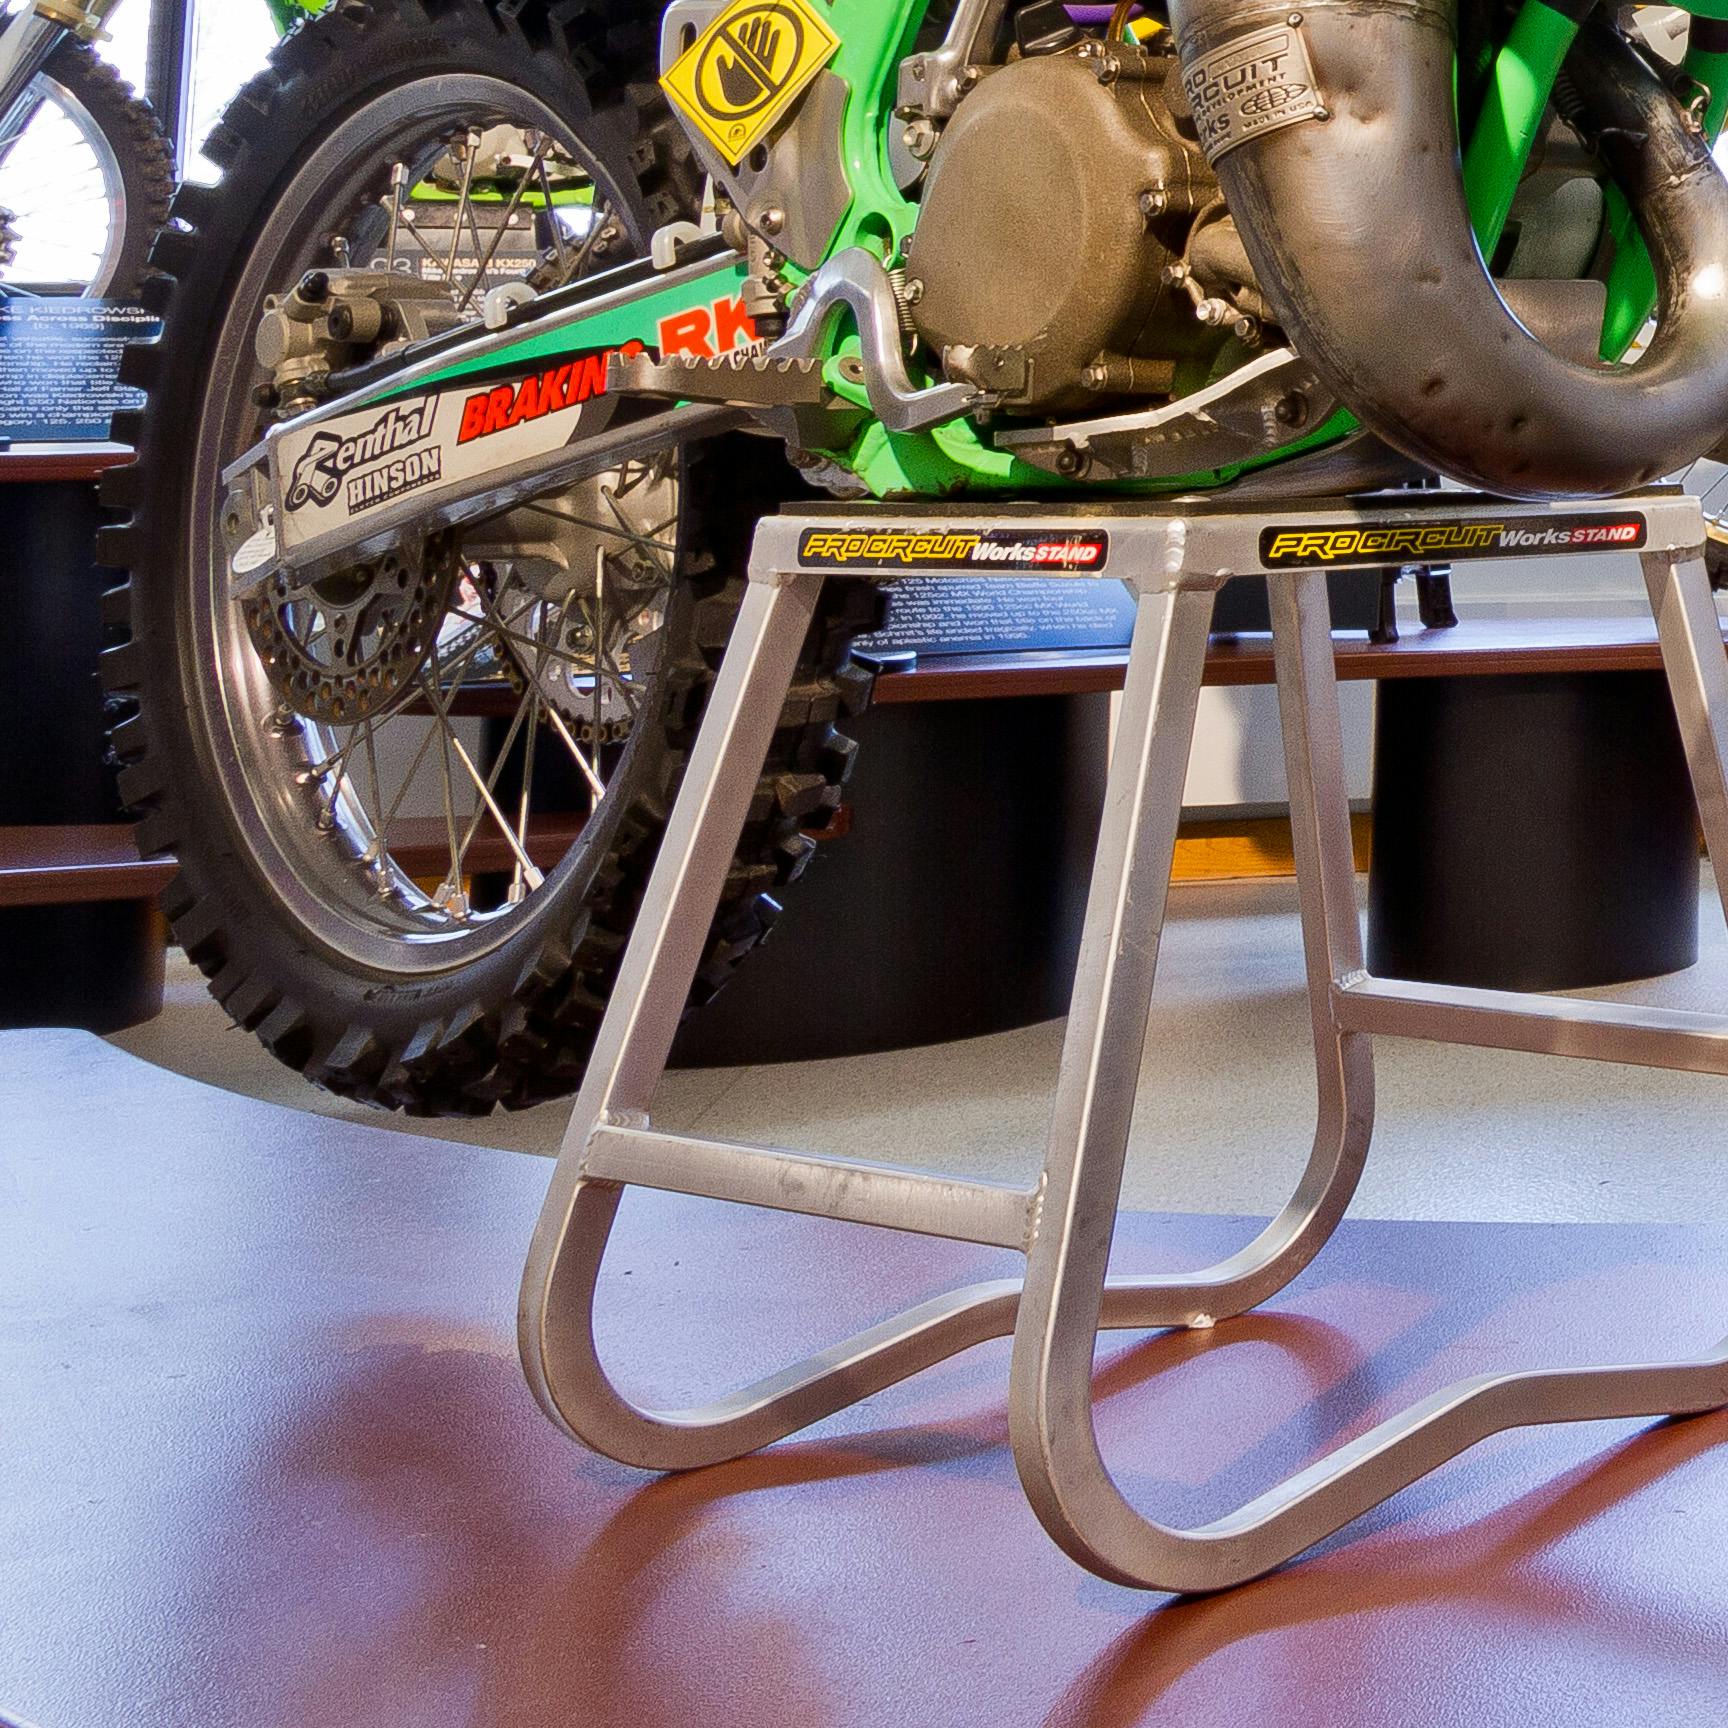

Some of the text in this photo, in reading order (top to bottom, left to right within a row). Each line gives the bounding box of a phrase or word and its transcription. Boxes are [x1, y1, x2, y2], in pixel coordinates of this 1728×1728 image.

[1190, 52, 1289, 111] RCUIT
[30, 306, 145, 315] KIEDROWS
[656, 297, 758, 360] RK
[286, 394, 442, 511] Renthal
[346, 445, 442, 508] HINSON
[803, 534, 1098, 563] PRO CIRCUIT Works STAND
[1270, 524, 1639, 561] PRO CIRCUIT Works STAND
